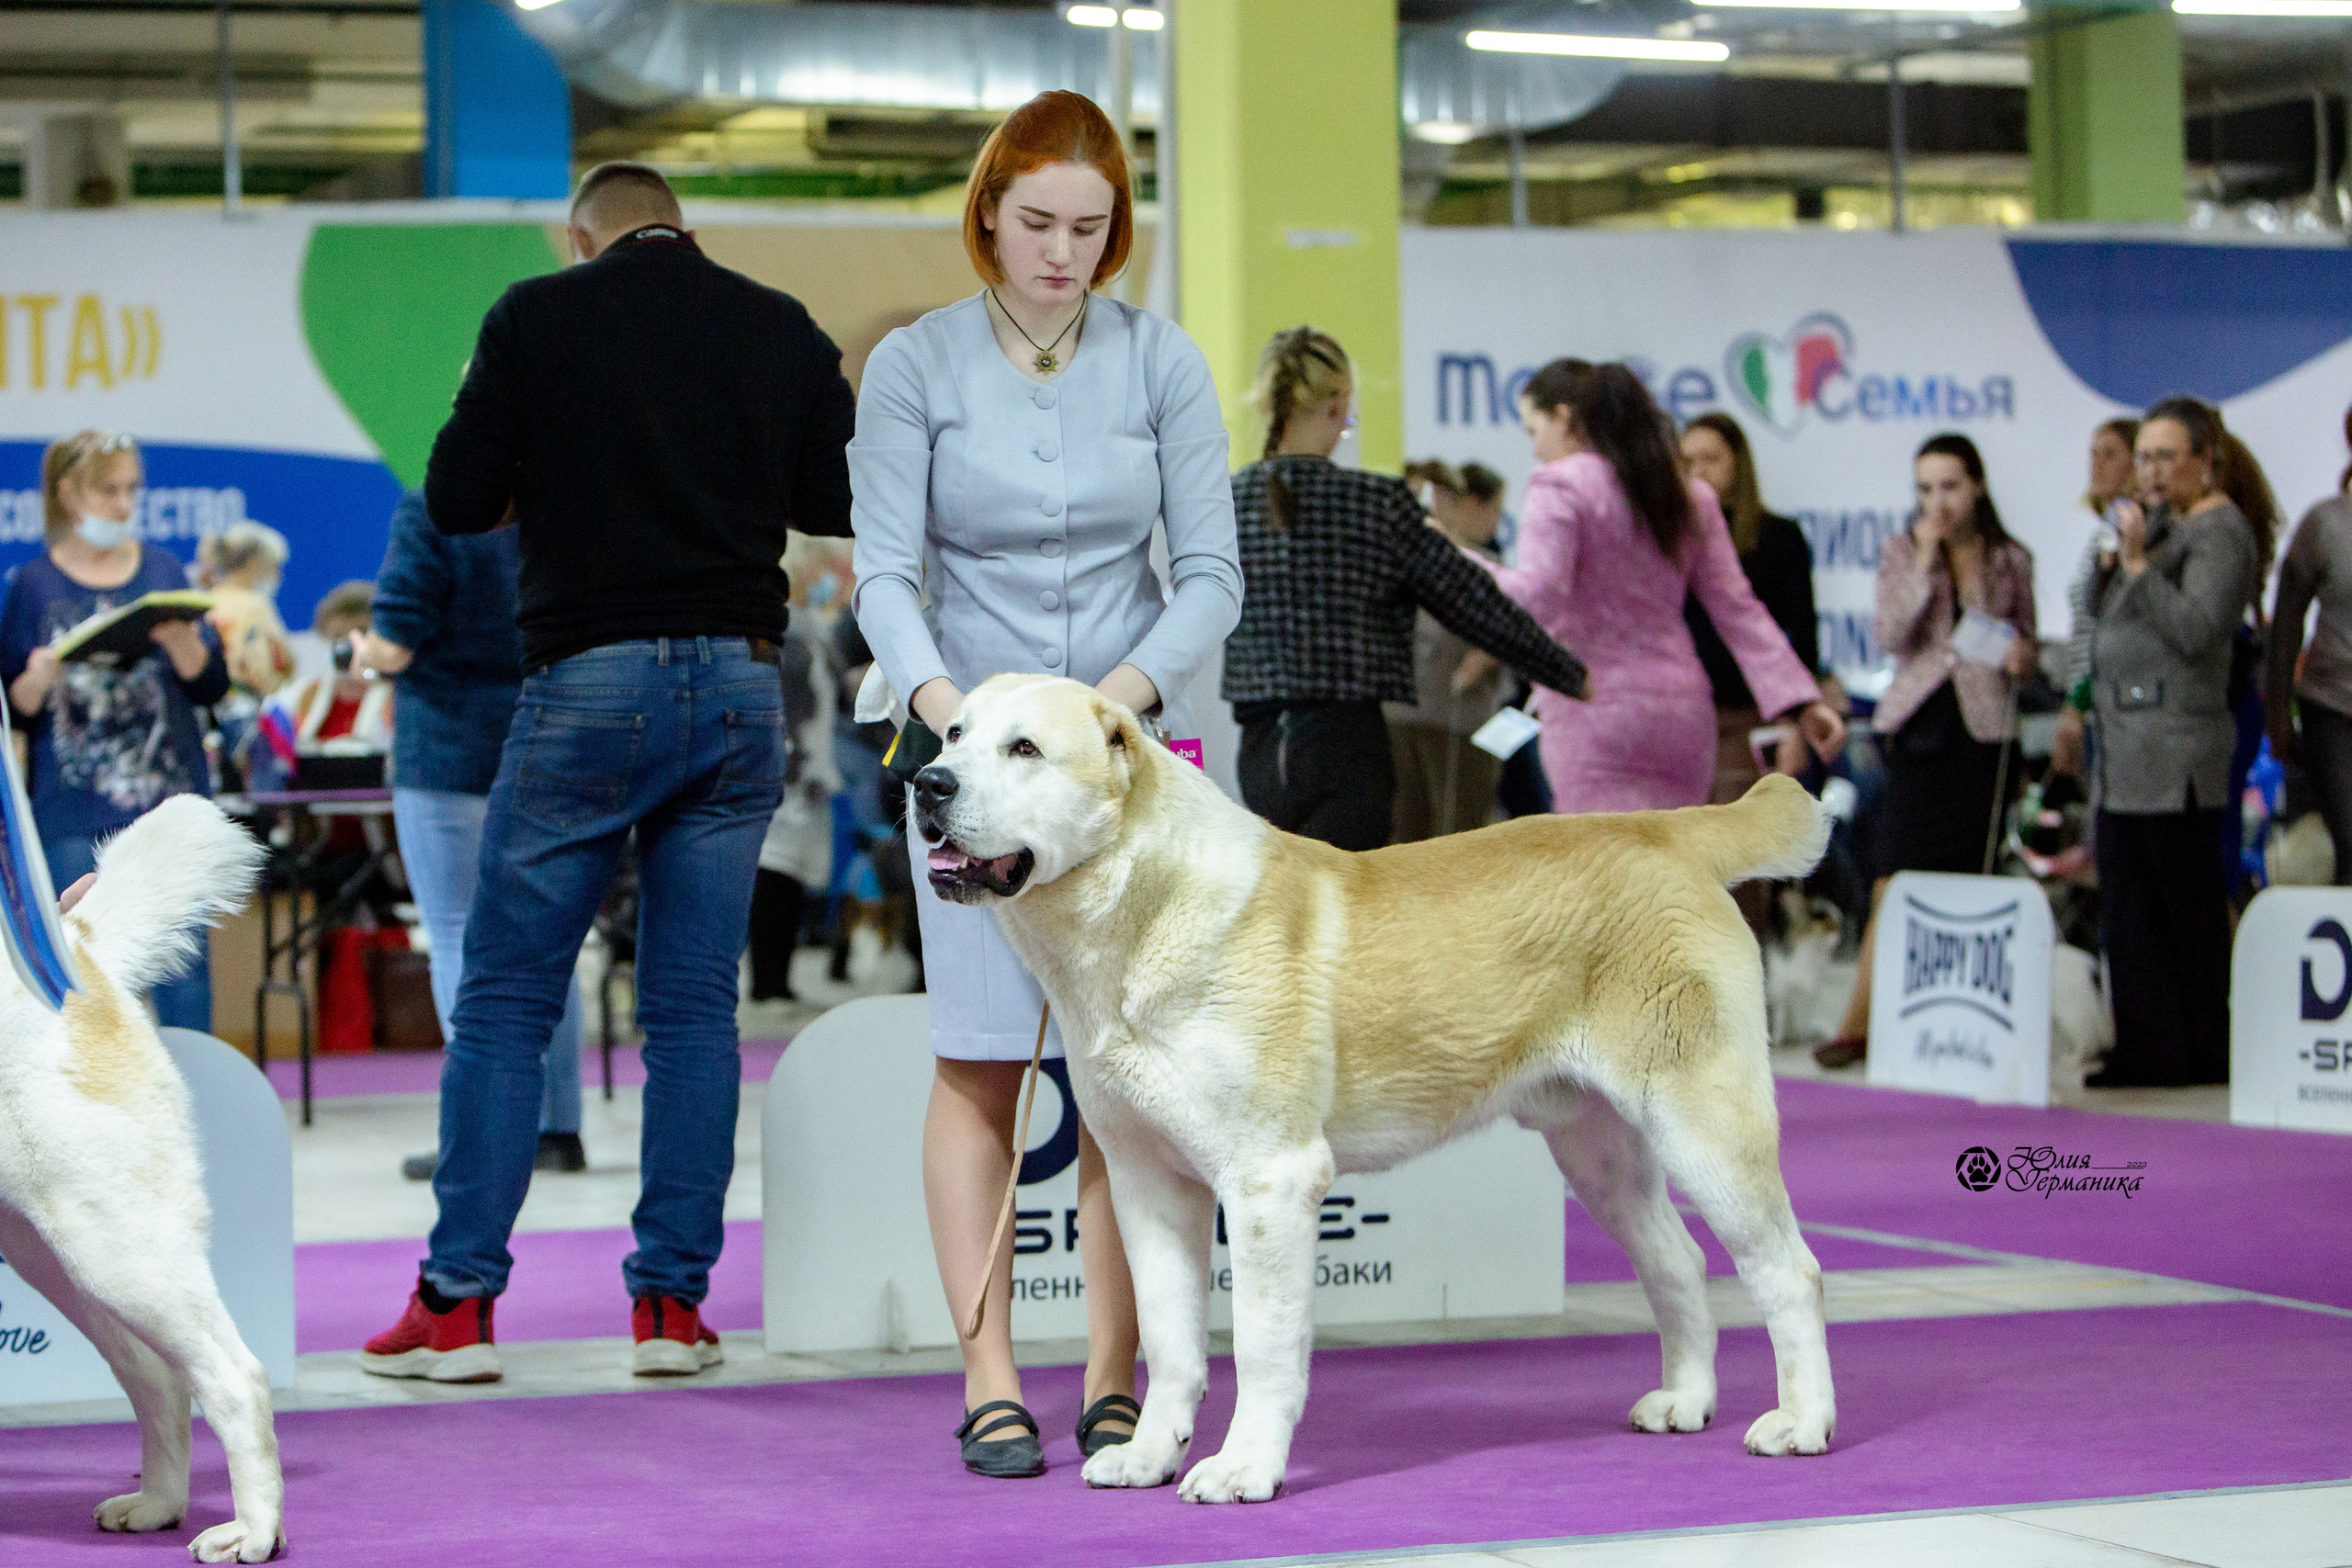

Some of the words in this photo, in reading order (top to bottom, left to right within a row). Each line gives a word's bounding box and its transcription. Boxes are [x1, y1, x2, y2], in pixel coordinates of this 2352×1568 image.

[0, 293, 164, 390] ТА»
[1905, 917, 1968, 996] HAPPY
[1971, 925, 2015, 1006] DOG
[1315, 1255, 1392, 1288] баки
